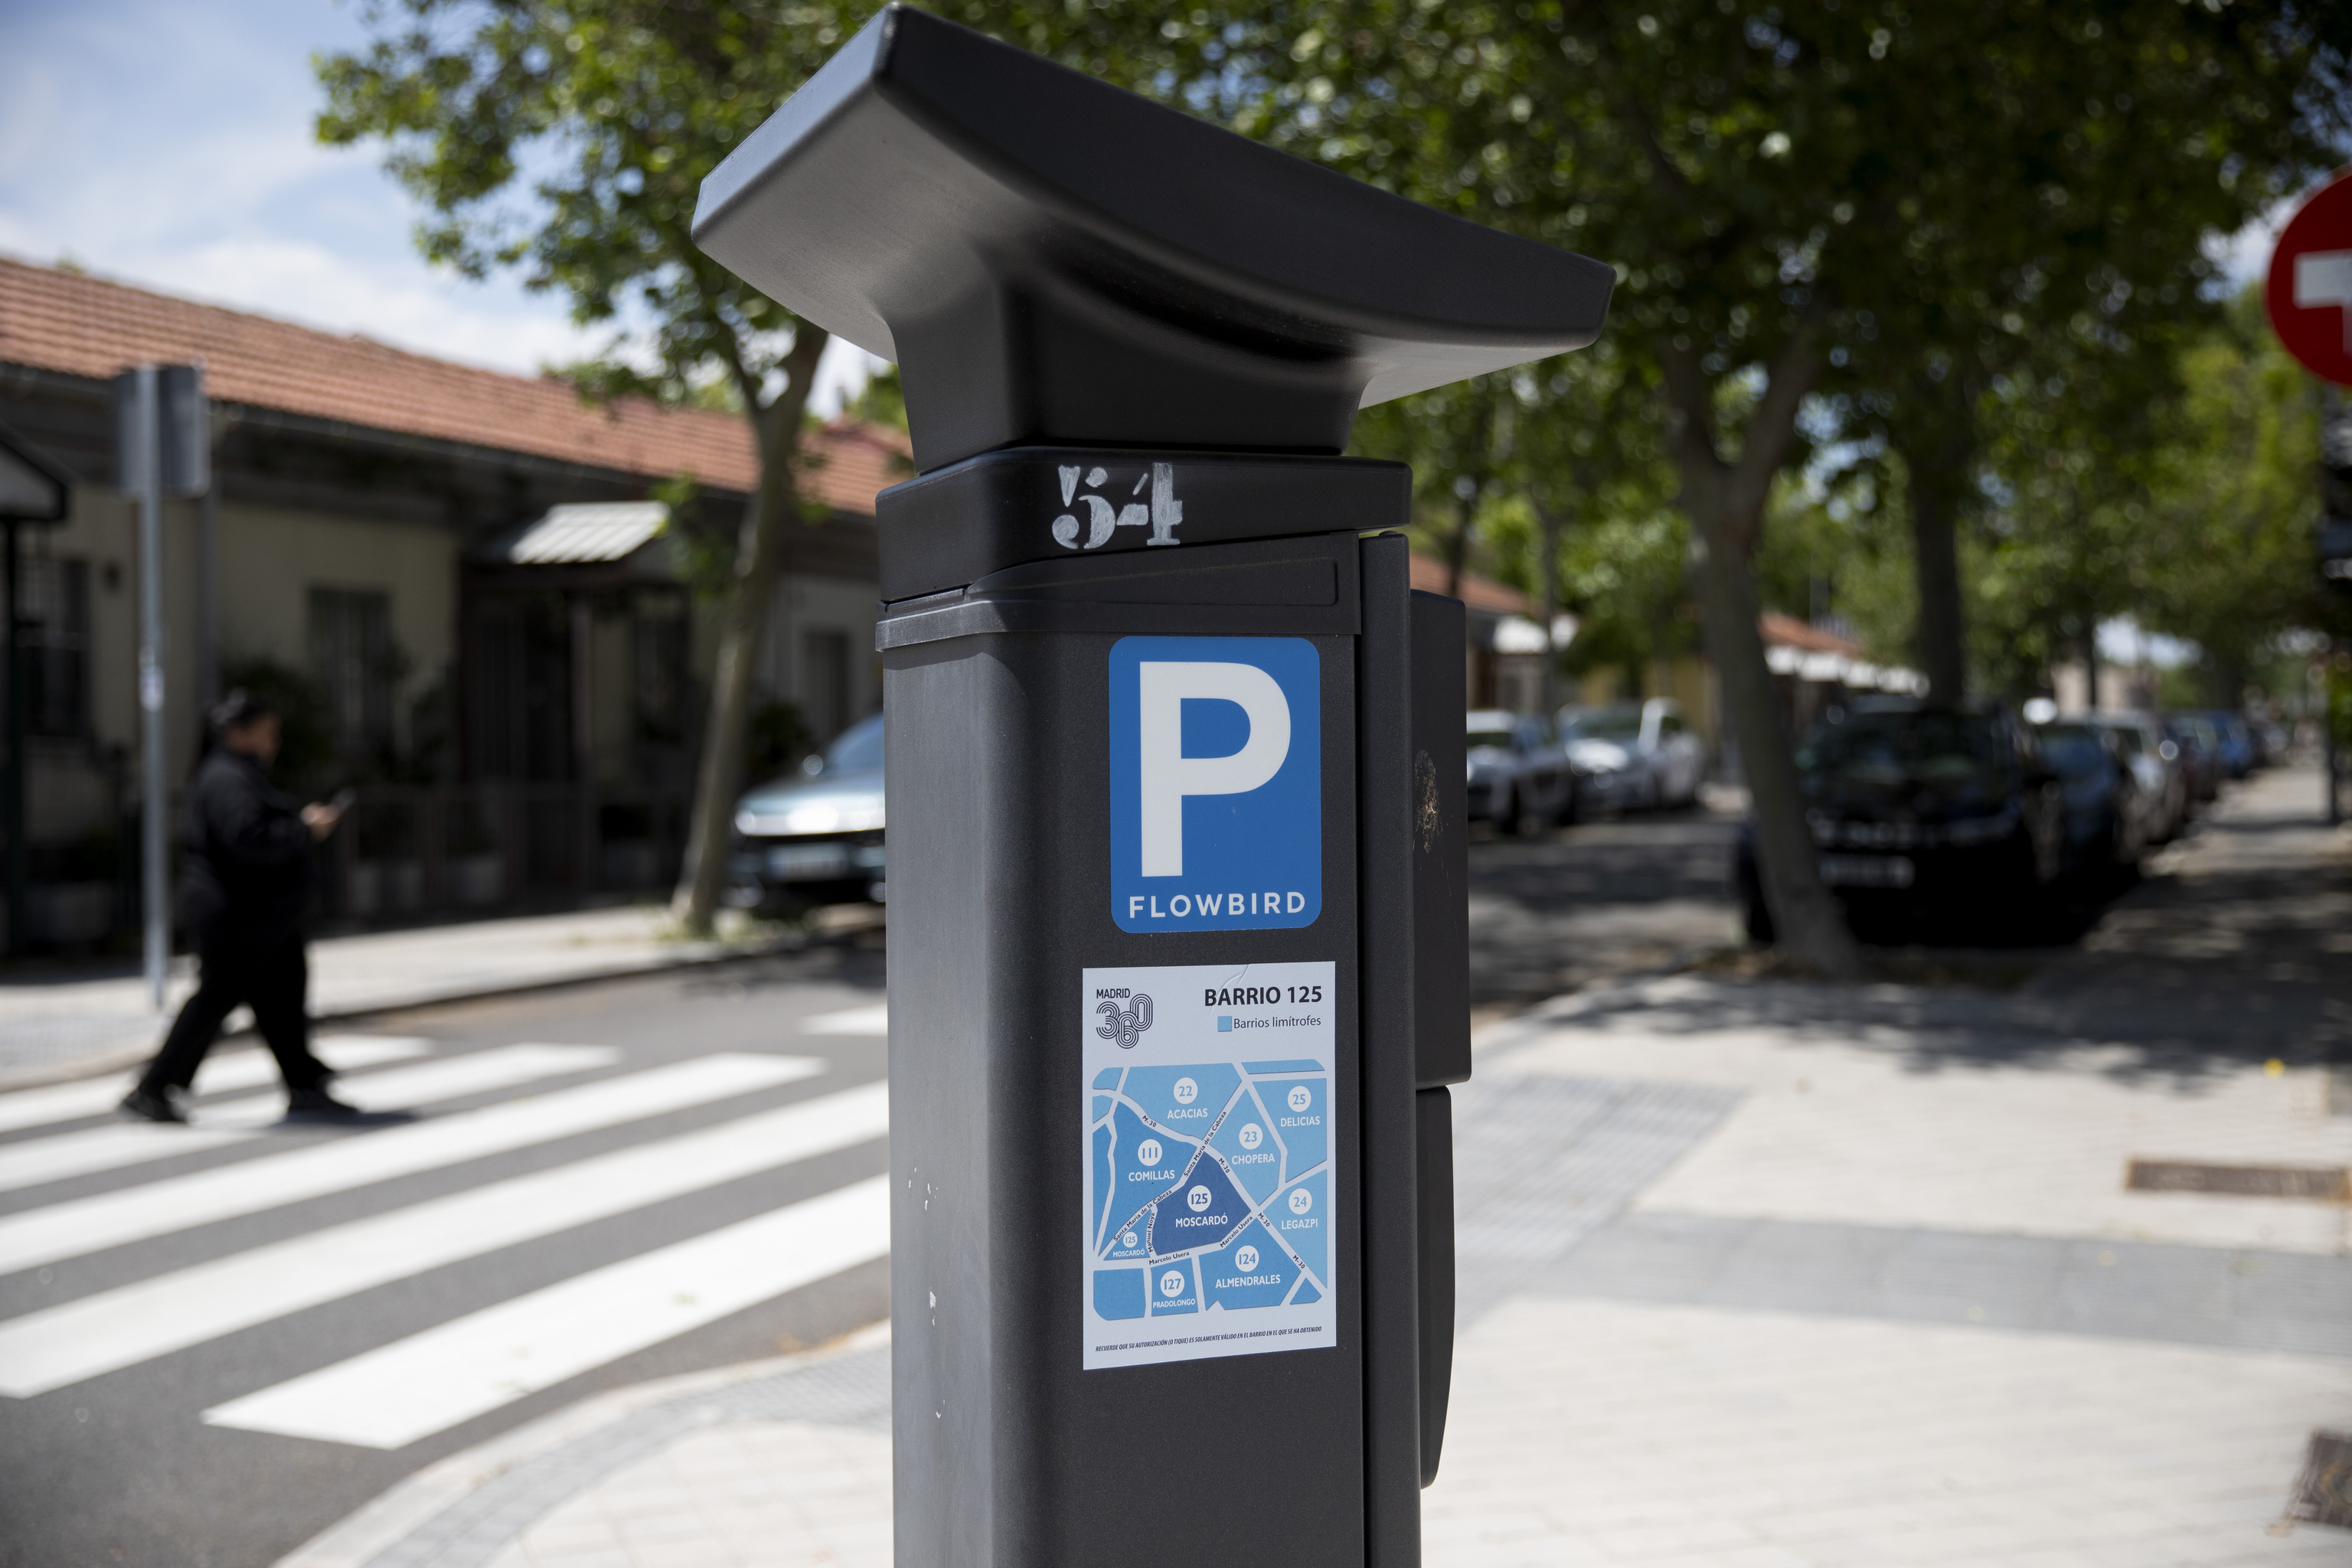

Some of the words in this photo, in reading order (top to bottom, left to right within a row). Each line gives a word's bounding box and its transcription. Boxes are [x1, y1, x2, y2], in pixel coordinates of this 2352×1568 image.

[1052, 462, 1183, 550] 54
[1139, 661, 1292, 877] P
[1129, 891, 1305, 919] FLOWBIRD
[1096, 988, 1131, 999] MADRID
[1204, 986, 1281, 1006] BARRIO
[1287, 985, 1322, 1004] 125
[1096, 993, 1153, 1049] 360
[1233, 1017, 1269, 1029] Barrios
[1272, 1014, 1321, 1027] limítrofes
[1178, 1085, 1193, 1097] 22
[1292, 1093, 1306, 1106] 25
[1167, 1108, 1208, 1119] ACACIAS
[1280, 1116, 1321, 1127] DELICIAS
[1243, 1131, 1258, 1142] 23
[1184, 1161, 1196, 1177] Santa
[1212, 1111, 1227, 1131] Cabeza
[1231, 1153, 1276, 1165] CHOPERA
[1128, 1169, 1175, 1181] COMILLAS
[1191, 1193, 1208, 1205] 125
[1293, 1196, 1308, 1207] 24
[1113, 1227, 1128, 1242] Santa
[1152, 1190, 1172, 1204] Cabeza
[1175, 1212, 1228, 1228] MOSCARDÓ
[1281, 1218, 1318, 1230] LEGAZPI
[1220, 1230, 1239, 1248] Marcelo
[1238, 1216, 1253, 1230] Usera
[1112, 1247, 1145, 1258] MOSCARDÓ
[1148, 1256, 1171, 1265] Marcelo
[1172, 1251, 1190, 1259] Usera
[1239, 1253, 1256, 1265] 124
[1164, 1278, 1182, 1291] 127
[1215, 1274, 1281, 1289] ALMENDRALES
[1152, 1298, 1196, 1308] PRADOLONGO
[1135, 1339, 1168, 1348] AUTORIZACIÓN
